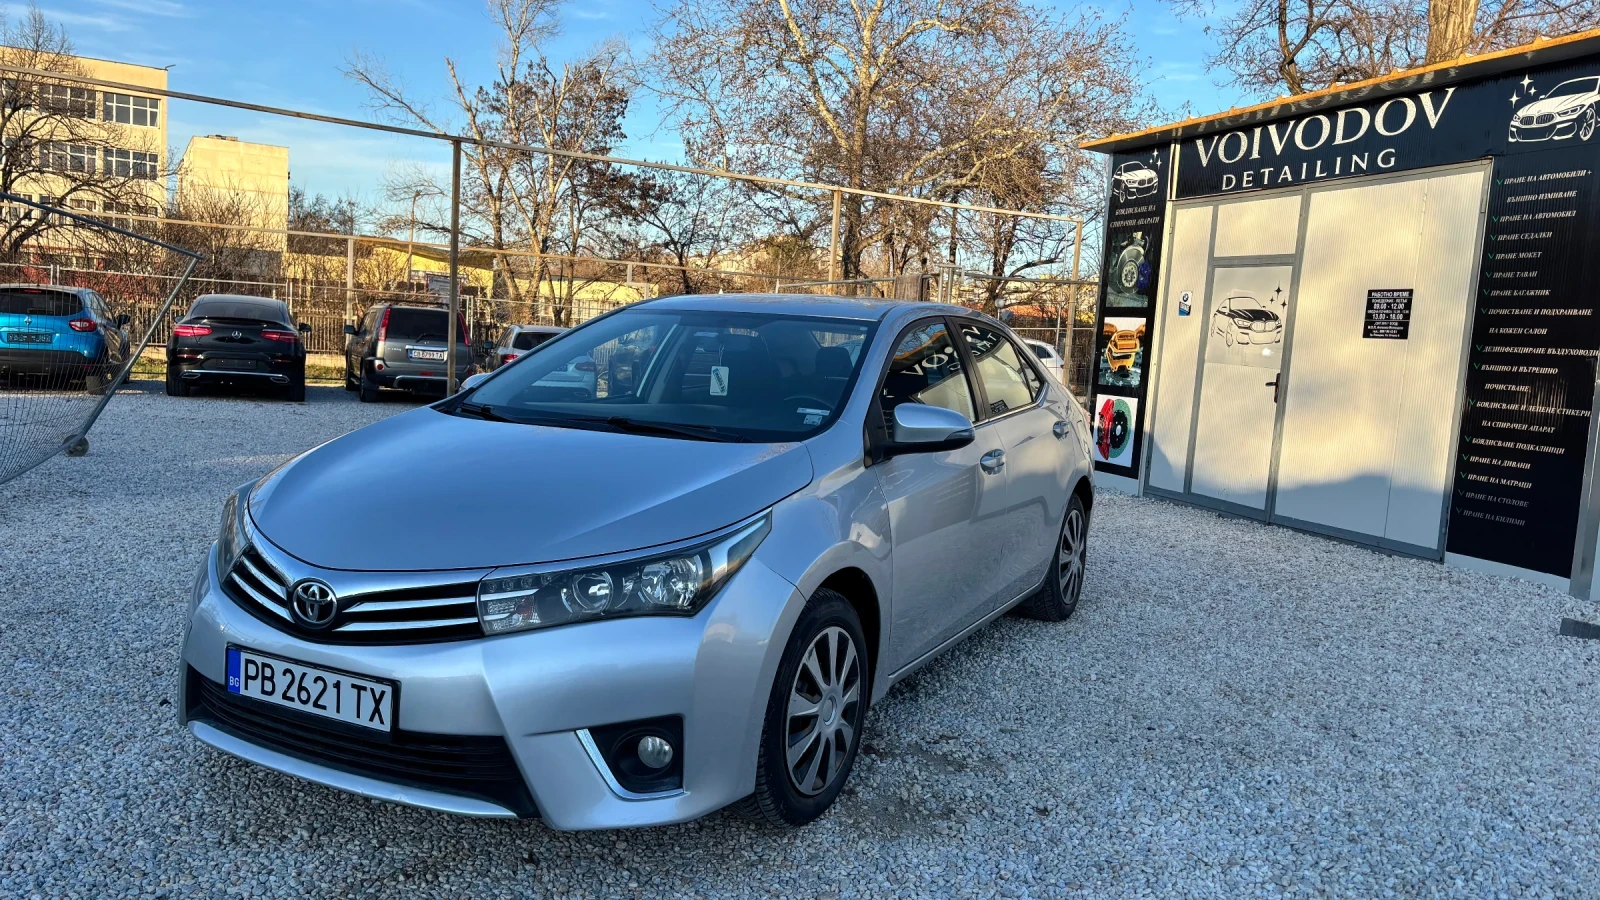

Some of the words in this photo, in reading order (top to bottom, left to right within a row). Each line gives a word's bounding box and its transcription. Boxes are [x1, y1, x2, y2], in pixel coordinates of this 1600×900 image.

[1195, 87, 1457, 168] VOIVODOV
[1221, 148, 1396, 191] DETAILING
[1504, 176, 1526, 185] ПРАНЕ
[1537, 169, 1587, 181] АВТОМОБИЛИ
[1506, 194, 1538, 203] ВЪНШНО
[1538, 190, 1578, 200] ИЗМИВАНЕ
[1500, 214, 1522, 222] ПРАНЕ
[1533, 210, 1577, 219] АВТОМОБИЛ
[1497, 233, 1520, 241] ПРАНЕ
[1520, 231, 1553, 240] СЕДАЛКИ
[1495, 252, 1518, 260] ПРАНЕ
[1518, 251, 1542, 259] МОКЕТ
[1516, 270, 1538, 278] ТАВАН
[1490, 289, 1513, 297] ПРАНЕ
[1540, 308, 1593, 316] ПОДХРАНВАНЕ
[1483, 346, 1546, 355] ДЕЗИНФЕКЦИРАНЕ
[1481, 364, 1512, 372] ВЪНШНО
[1518, 365, 1558, 375] ВЪТРЕШНО
[1484, 383, 1530, 392] ПОЧИСТВАНЕ
[1476, 401, 1520, 411] БОЯДИСВАНЕ
[1526, 405, 1557, 414] ЛЕПЕНЕ
[1556, 408, 1591, 417] СТИКЕРИ
[1491, 421, 1528, 431] СПИРАЧЕН
[1528, 425, 1556, 433] АПАРАТ
[1472, 437, 1515, 449] БОЯДИСВАНЕ
[1515, 442, 1565, 455] ПОДКАЛНИЦИ
[1469, 455, 1491, 464] ПРАНЕ
[1491, 458, 1501, 466] НА
[1501, 460, 1531, 470] ДИВАНИ
[1467, 473, 1489, 482] ПРАНЕ
[1499, 478, 1532, 489] МАТРАЦИ
[1465, 491, 1487, 501] ПРАНЕ
[1497, 497, 1529, 507] СТОЛОВЕ
[1463, 509, 1484, 519] ПРАНЕ
[1495, 515, 1525, 526] КИЛИМИ
[229, 675, 239, 688] BG
[244, 658, 276, 697] PB
[282, 667, 341, 714] 2621
[351, 683, 387, 726] TX
